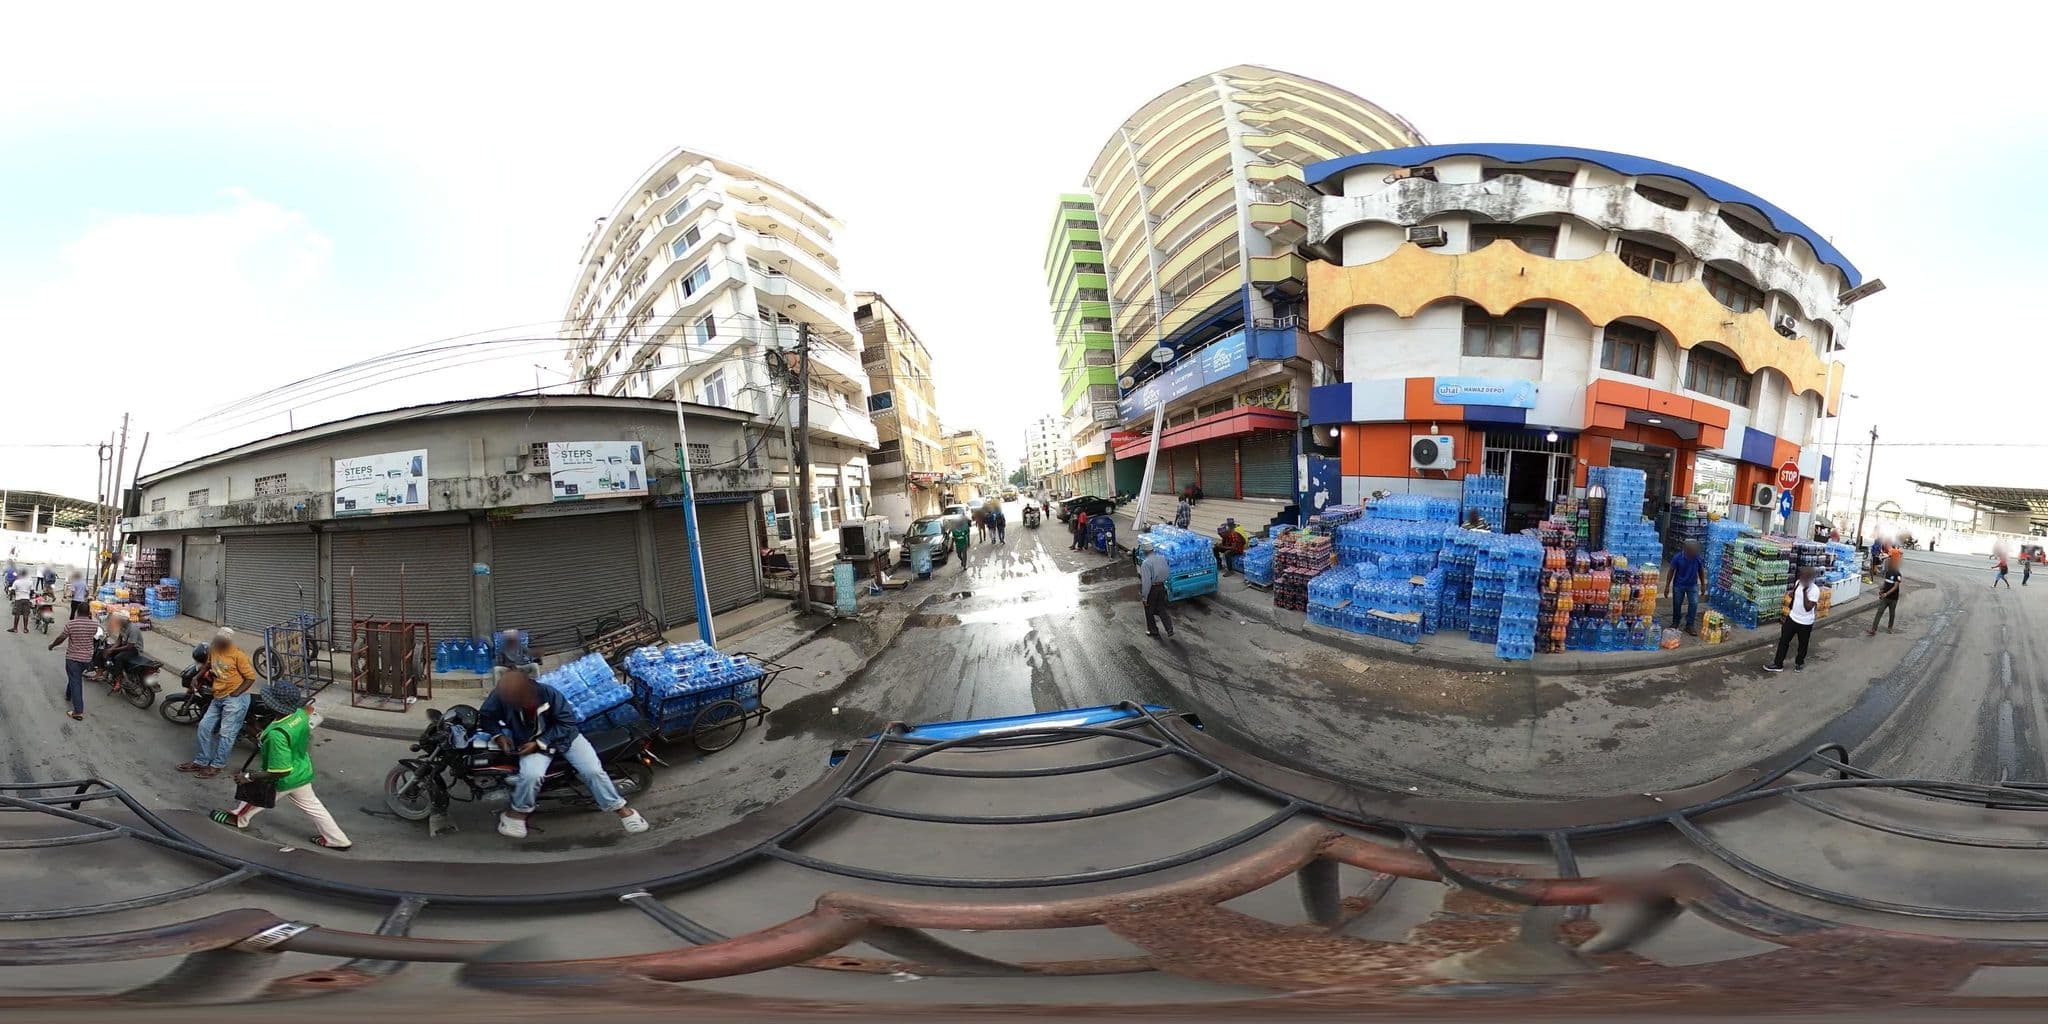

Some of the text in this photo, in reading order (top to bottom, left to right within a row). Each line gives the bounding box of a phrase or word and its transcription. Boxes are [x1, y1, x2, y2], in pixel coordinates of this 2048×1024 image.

[561, 449, 593, 458] STEPS
[345, 465, 373, 476] STEPS
[1781, 470, 1797, 482] STOP
